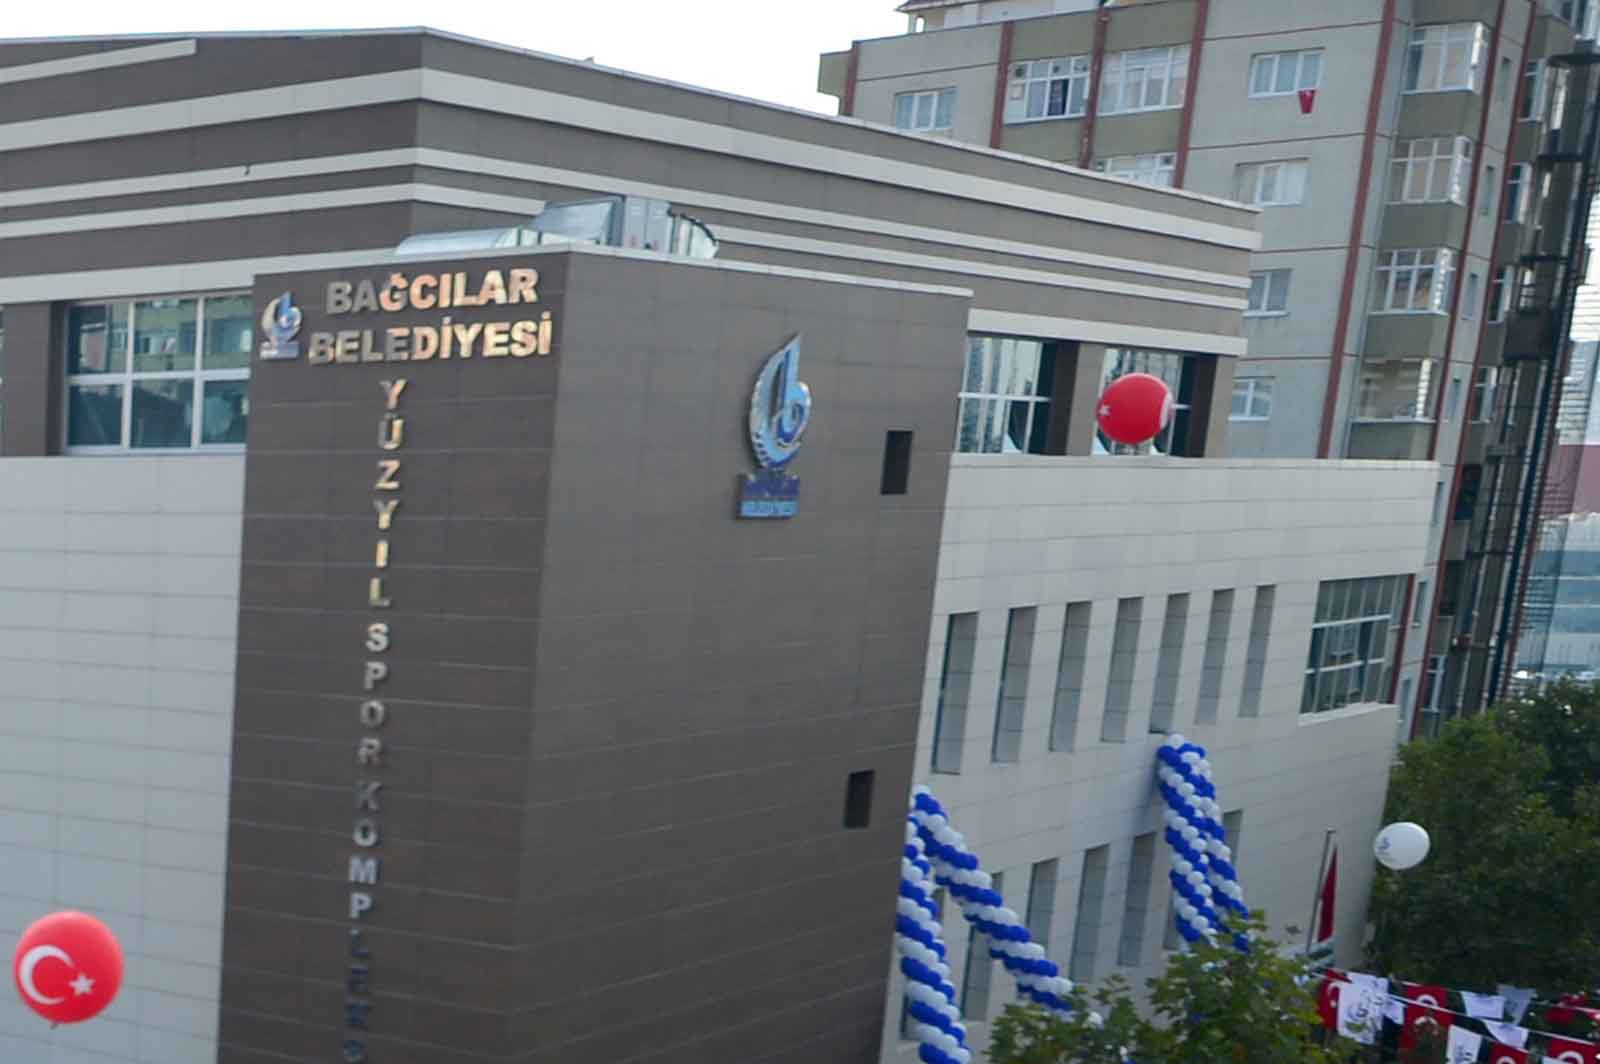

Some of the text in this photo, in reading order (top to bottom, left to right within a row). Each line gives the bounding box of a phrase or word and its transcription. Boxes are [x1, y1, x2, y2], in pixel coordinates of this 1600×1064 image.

[308, 311, 553, 365] BELEDİYESİ
[326, 268, 539, 315] BAĞCILAR
[368, 378, 408, 608] YÜZYIL
[357, 622, 389, 766] SPOR
